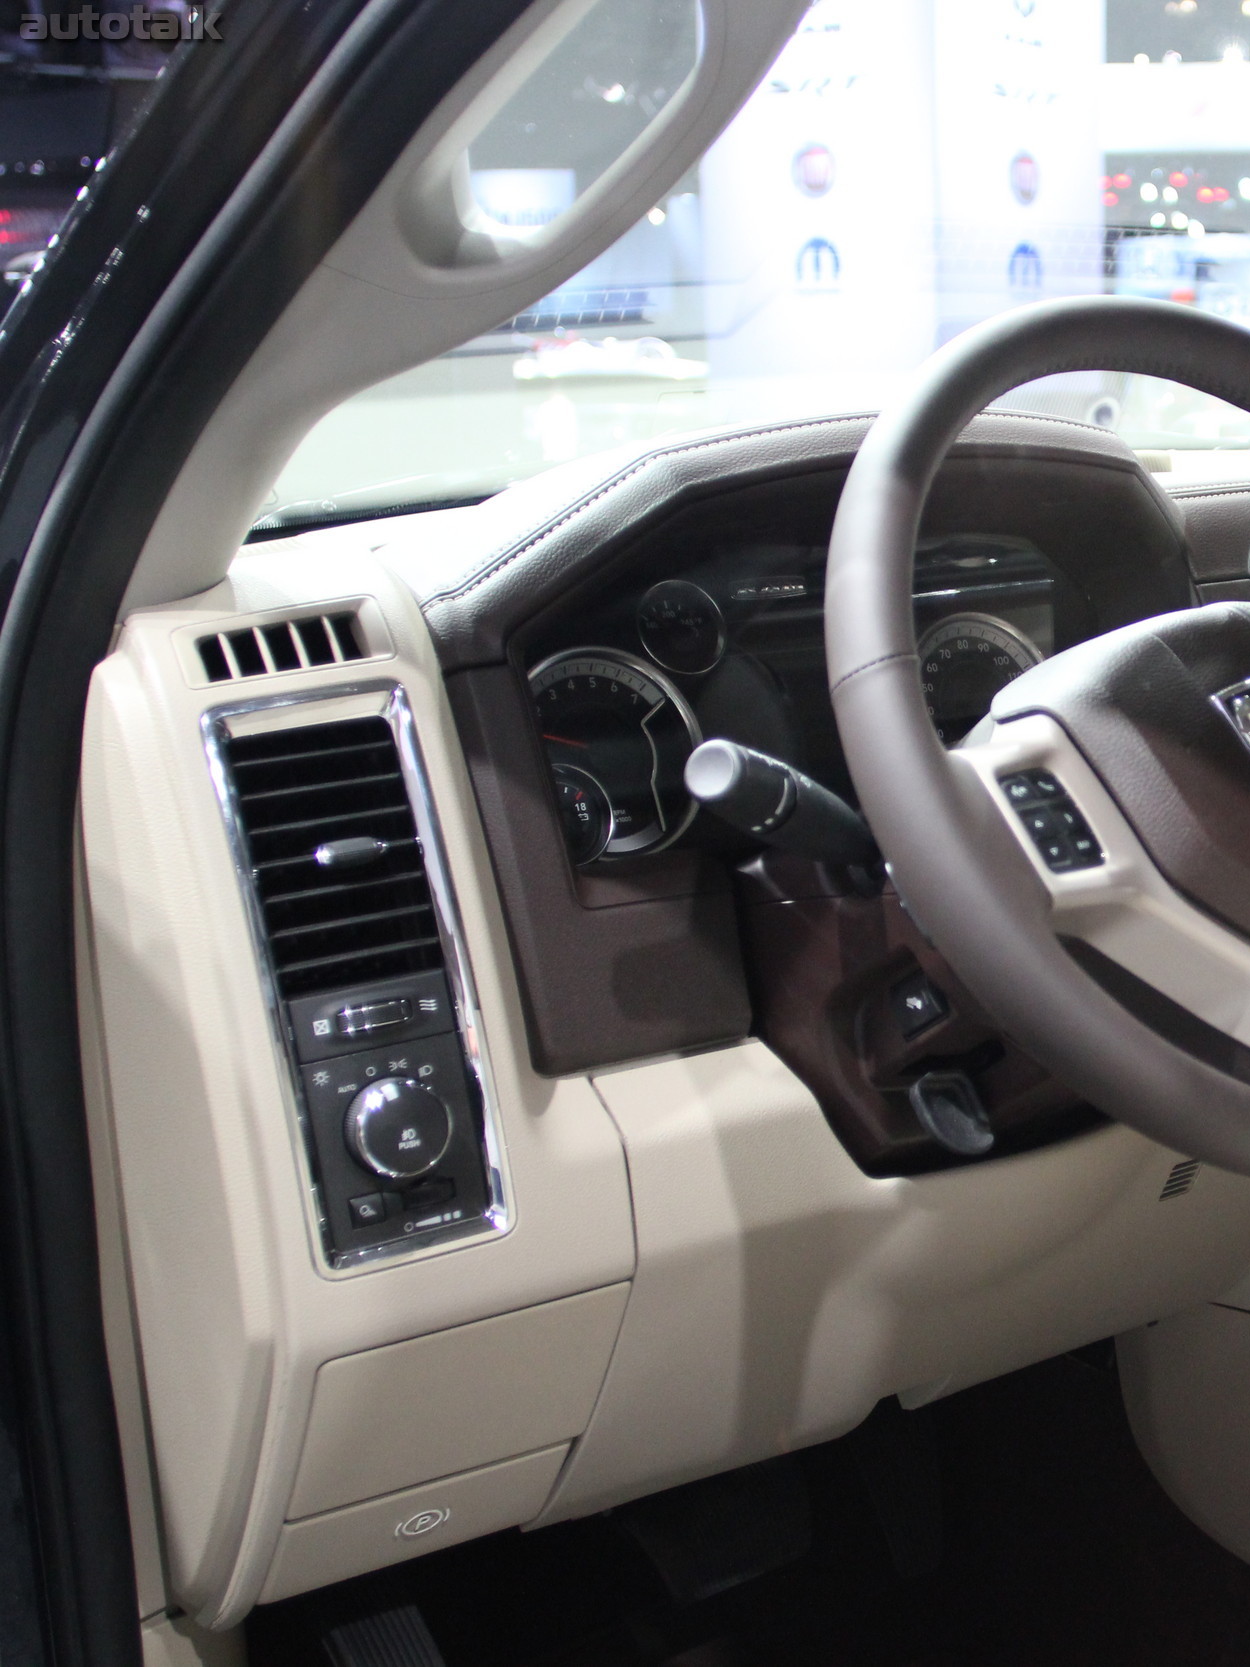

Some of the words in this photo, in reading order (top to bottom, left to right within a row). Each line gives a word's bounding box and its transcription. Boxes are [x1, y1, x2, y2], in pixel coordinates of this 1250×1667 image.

[957, 640, 969, 651] 80
[977, 643, 990, 653] 90
[940, 648, 952, 660] 70
[993, 656, 1010, 667] 100
[926, 663, 938, 673] 60
[567, 679, 575, 691] 4
[589, 677, 597, 688] 5
[610, 682, 618, 693] 6
[549, 688, 557, 701] 3
[630, 693, 639, 705] 7
[575, 802, 587, 812] 18
[338, 1084, 357, 1094] AUTO
[398, 1139, 421, 1151] PUSH
